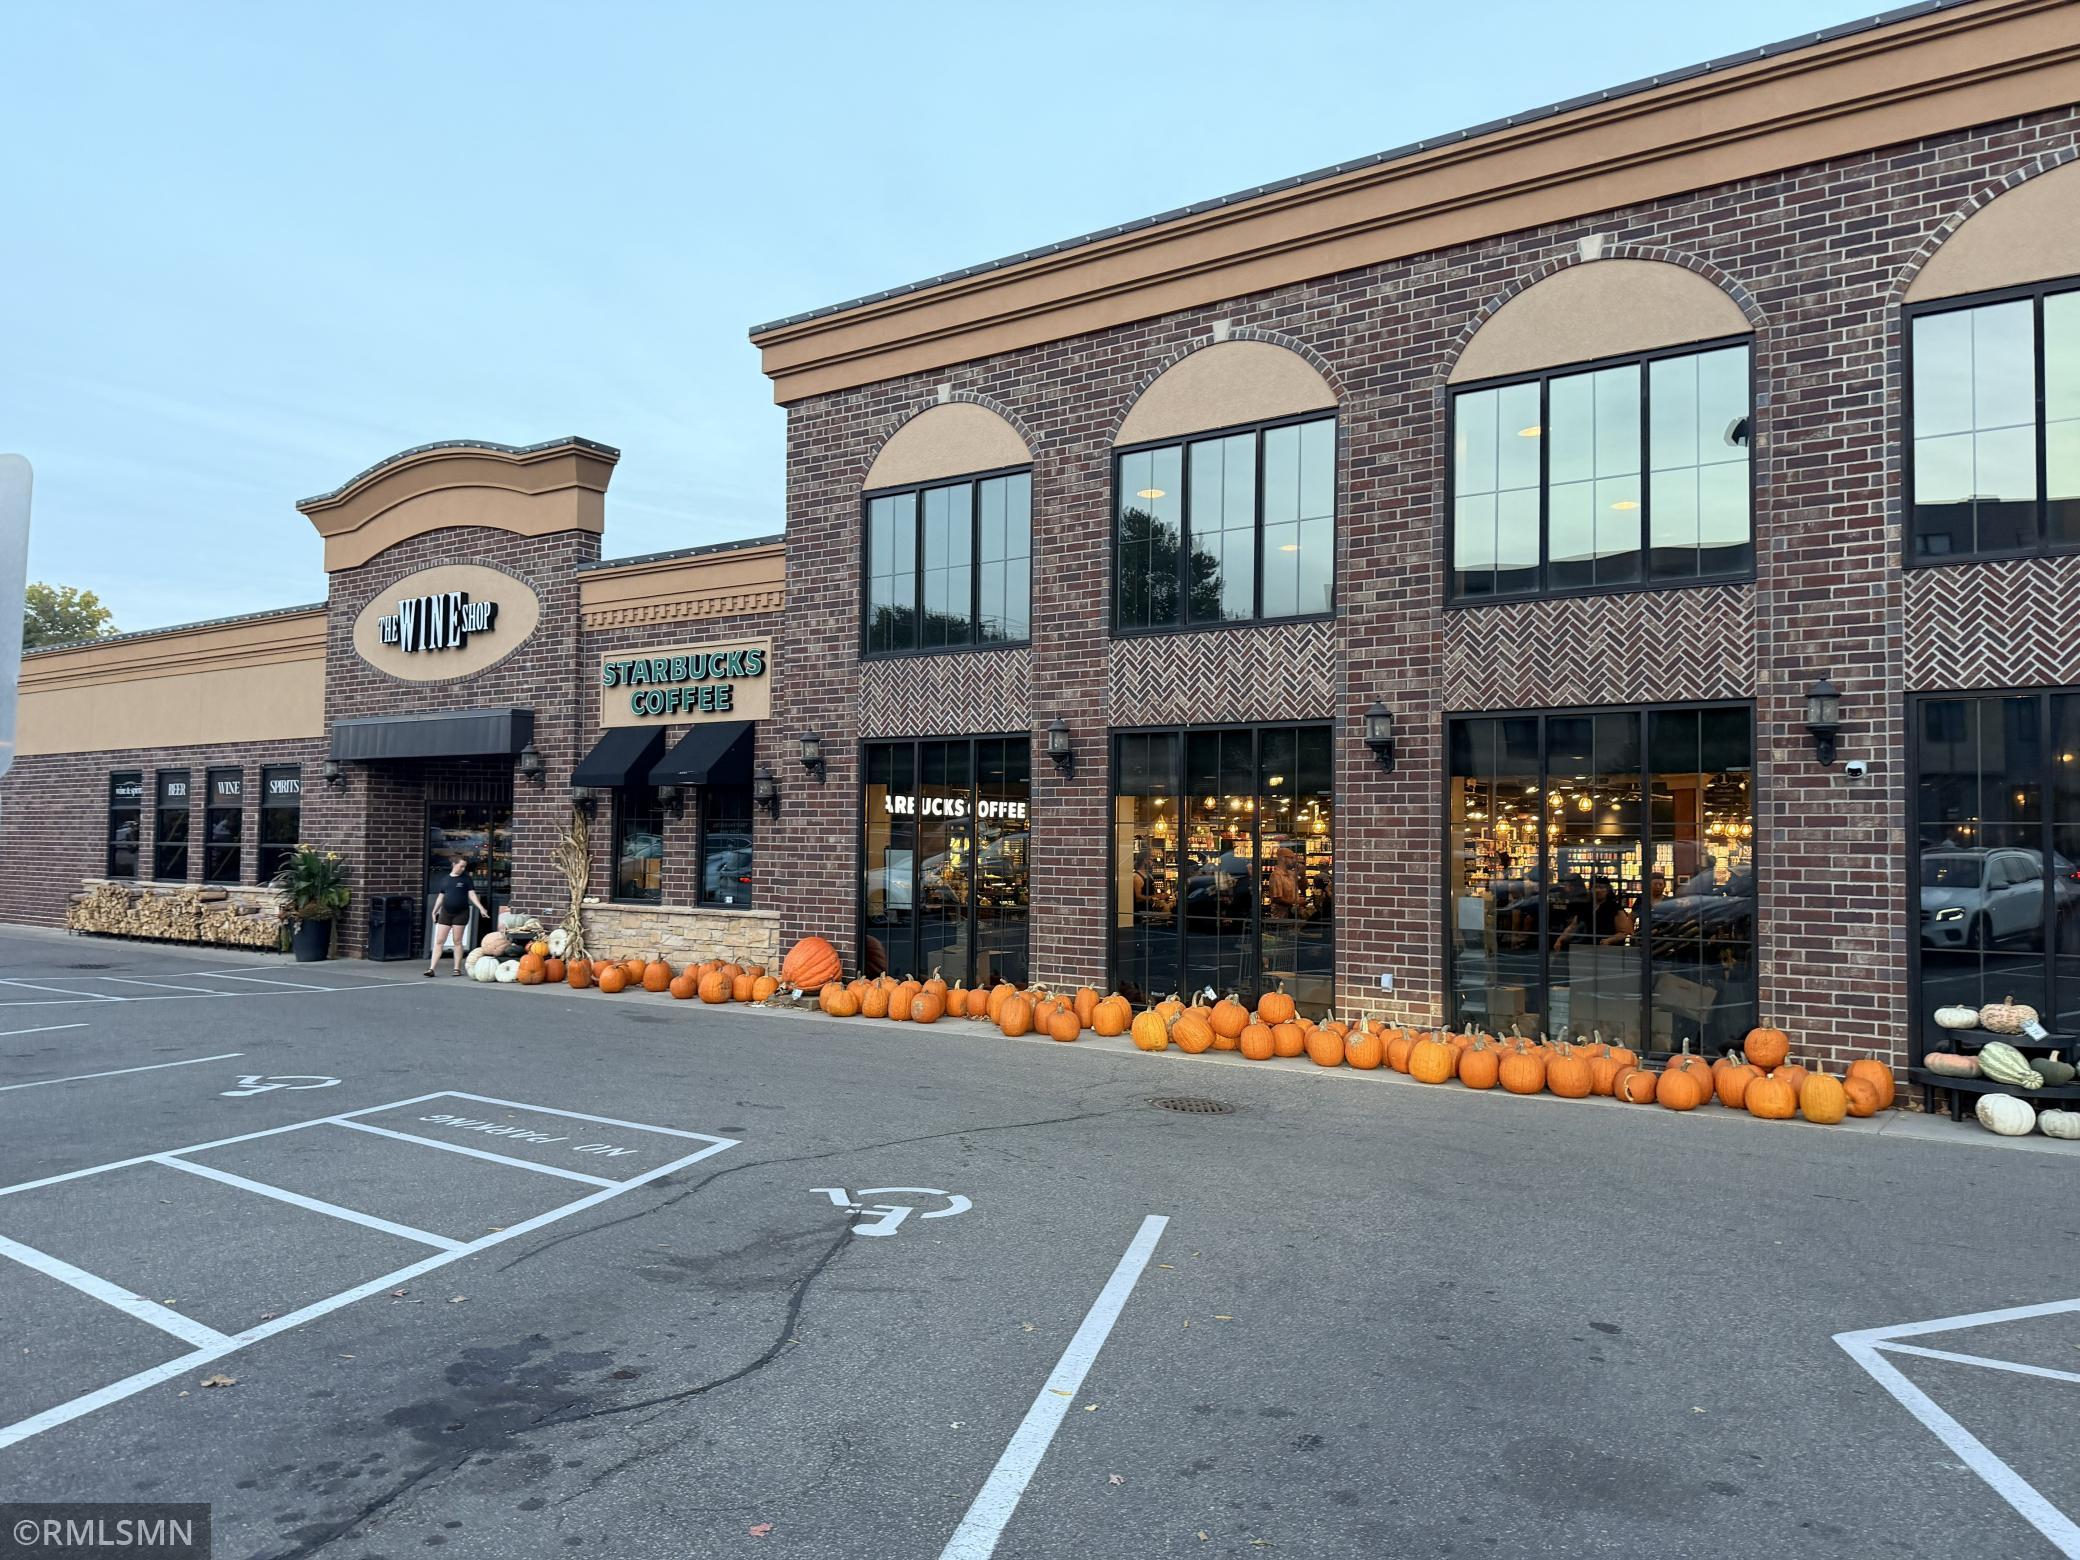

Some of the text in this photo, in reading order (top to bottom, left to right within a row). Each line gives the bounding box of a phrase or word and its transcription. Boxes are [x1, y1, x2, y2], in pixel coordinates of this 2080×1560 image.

[377, 591, 492, 652] THE WINE SHOP
[602, 647, 764, 687] STARBUCKS
[630, 684, 731, 716] COFFEE
[167, 783, 186, 796] BEER
[217, 780, 240, 795] WINE
[269, 779, 300, 794] SPIRITS
[968, 800, 1026, 819] OFFEE
[418, 1113, 638, 1157] NO PARKING
